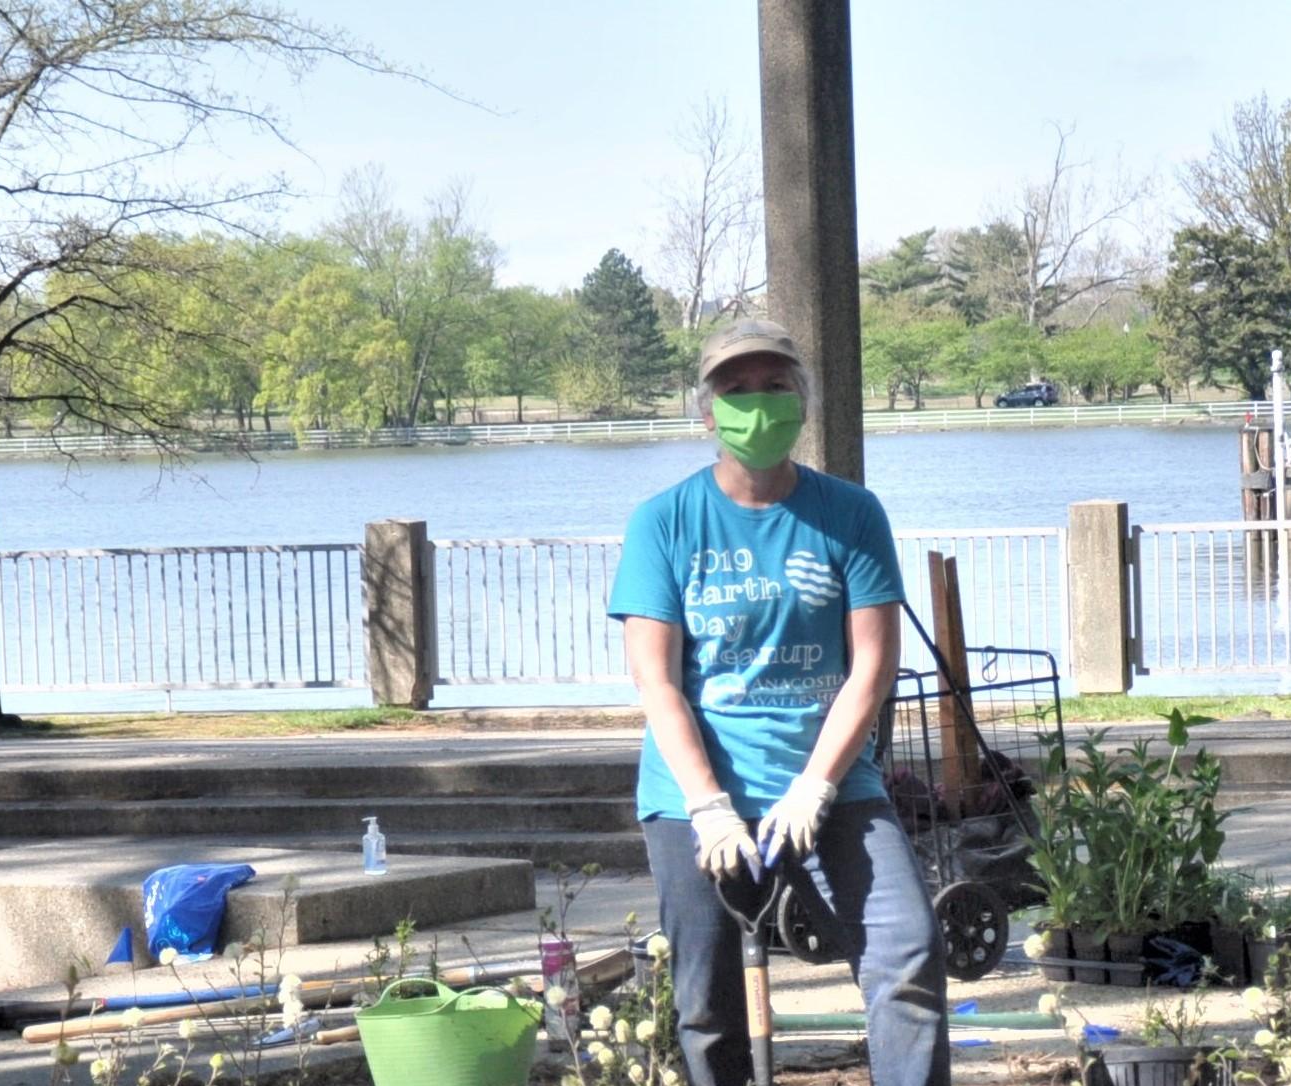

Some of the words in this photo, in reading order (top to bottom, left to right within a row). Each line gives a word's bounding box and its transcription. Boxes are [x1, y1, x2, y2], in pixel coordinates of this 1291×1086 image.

[685, 577, 782, 607] Earth
[685, 611, 748, 642] Day
[752, 674, 846, 690] ANACOSTIA
[751, 692, 838, 707] WATERSHE
